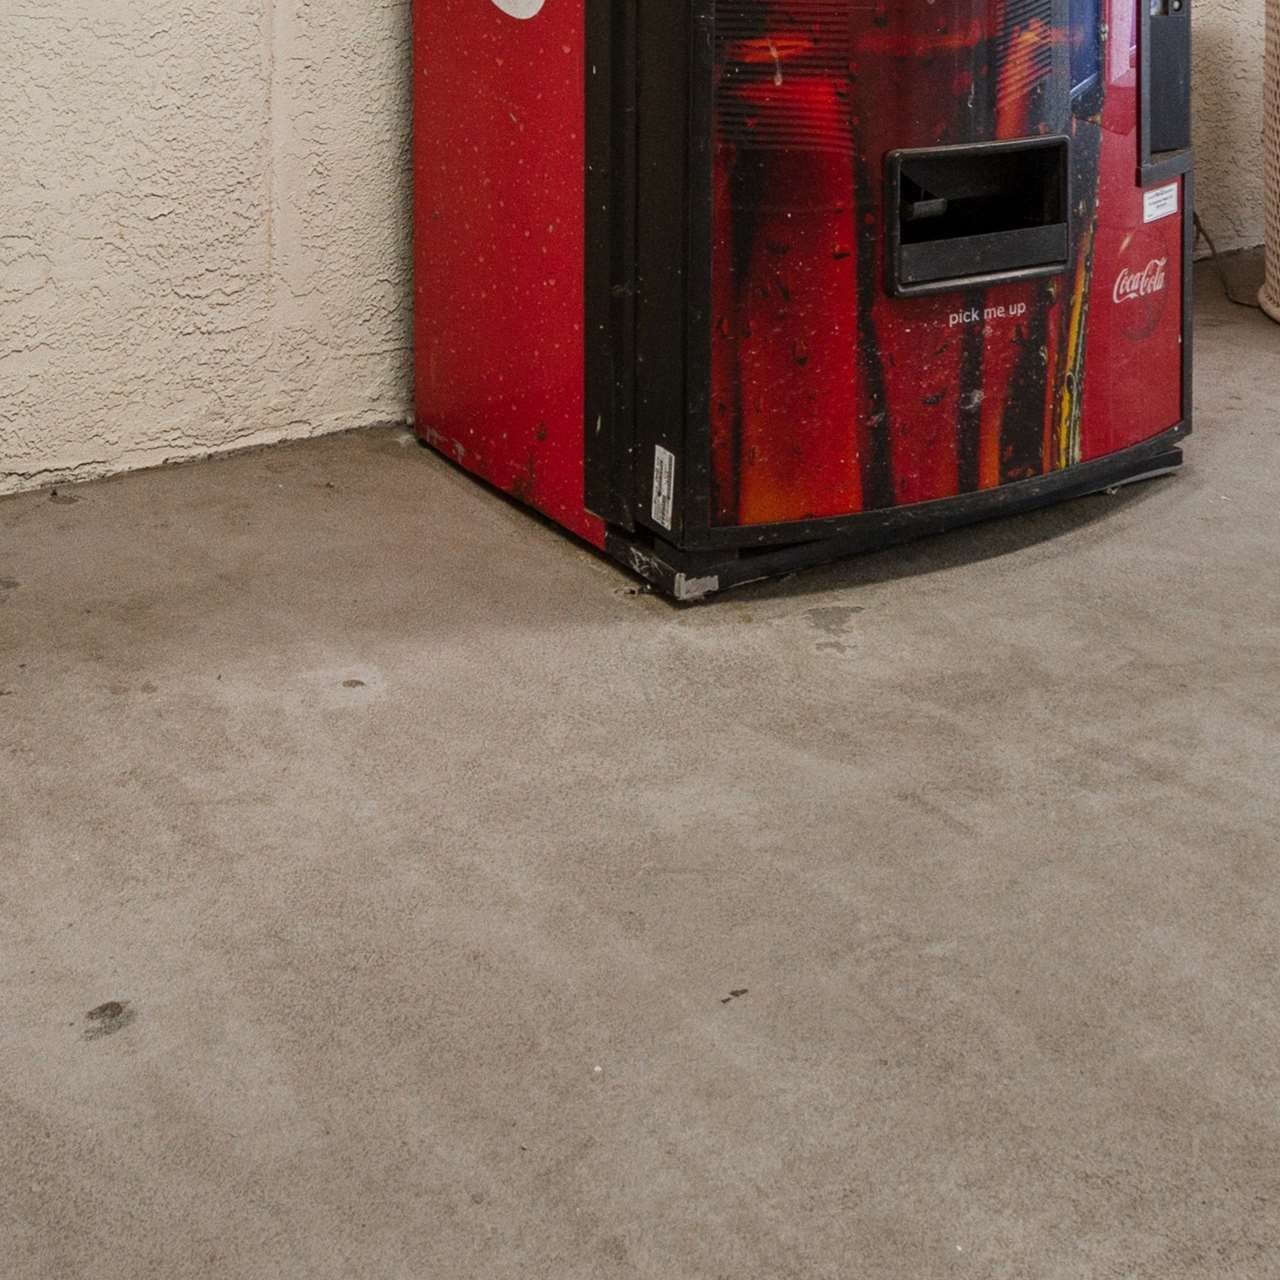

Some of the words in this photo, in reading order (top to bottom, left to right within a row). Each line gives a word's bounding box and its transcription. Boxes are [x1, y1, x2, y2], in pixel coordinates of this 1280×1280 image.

[1113, 257, 1168, 304] Coca-Cola
[949, 308, 980, 328] pick
[984, 306, 1006, 320] me
[1008, 302, 1027, 317] up
